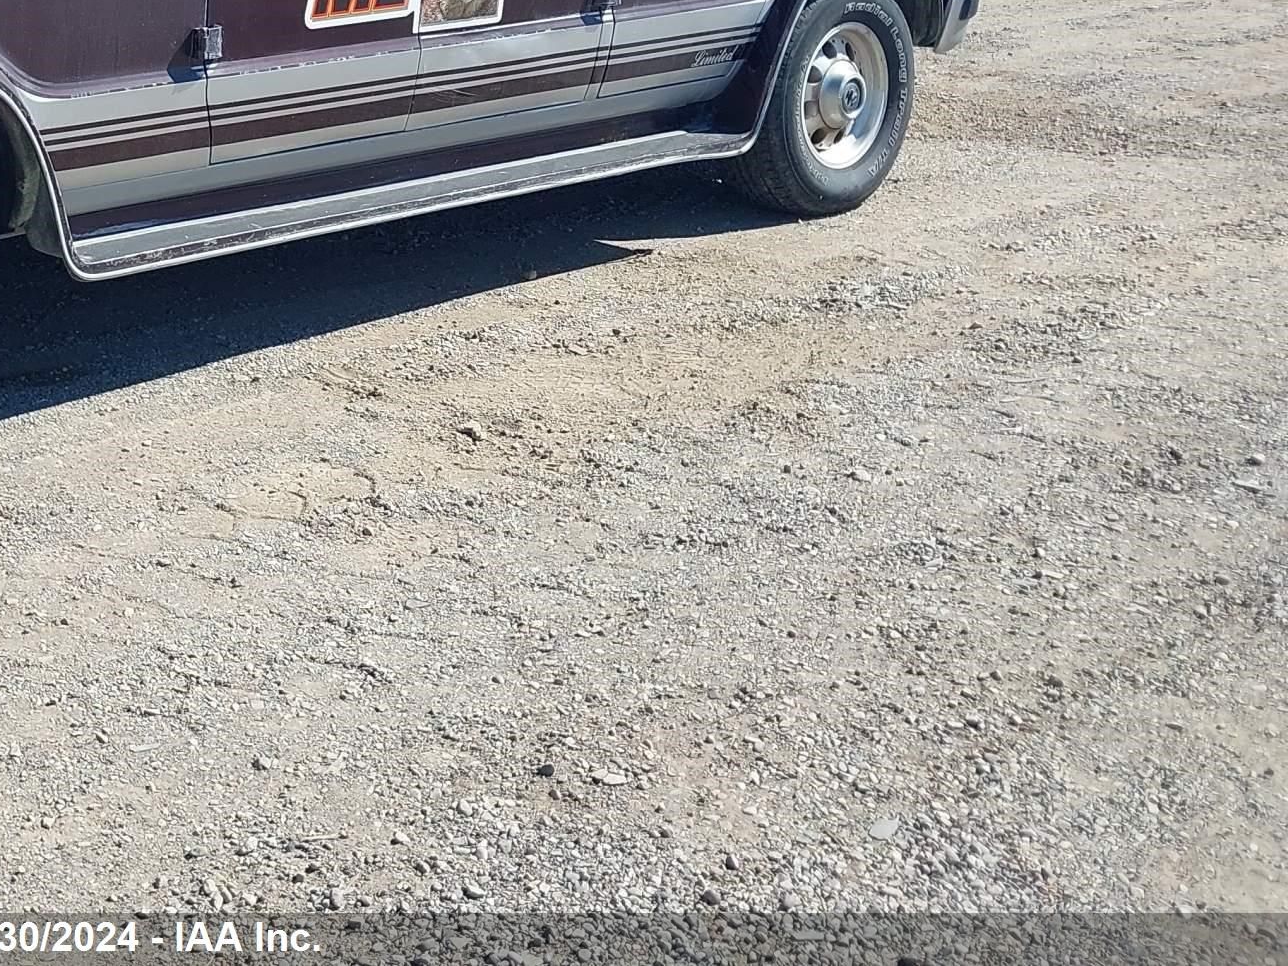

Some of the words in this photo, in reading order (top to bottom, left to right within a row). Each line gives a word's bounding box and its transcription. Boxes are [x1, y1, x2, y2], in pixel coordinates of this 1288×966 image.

[691, 44, 740, 68] Limited
[844, 1, 894, 27] Radial
[890, 25, 908, 83] Long
